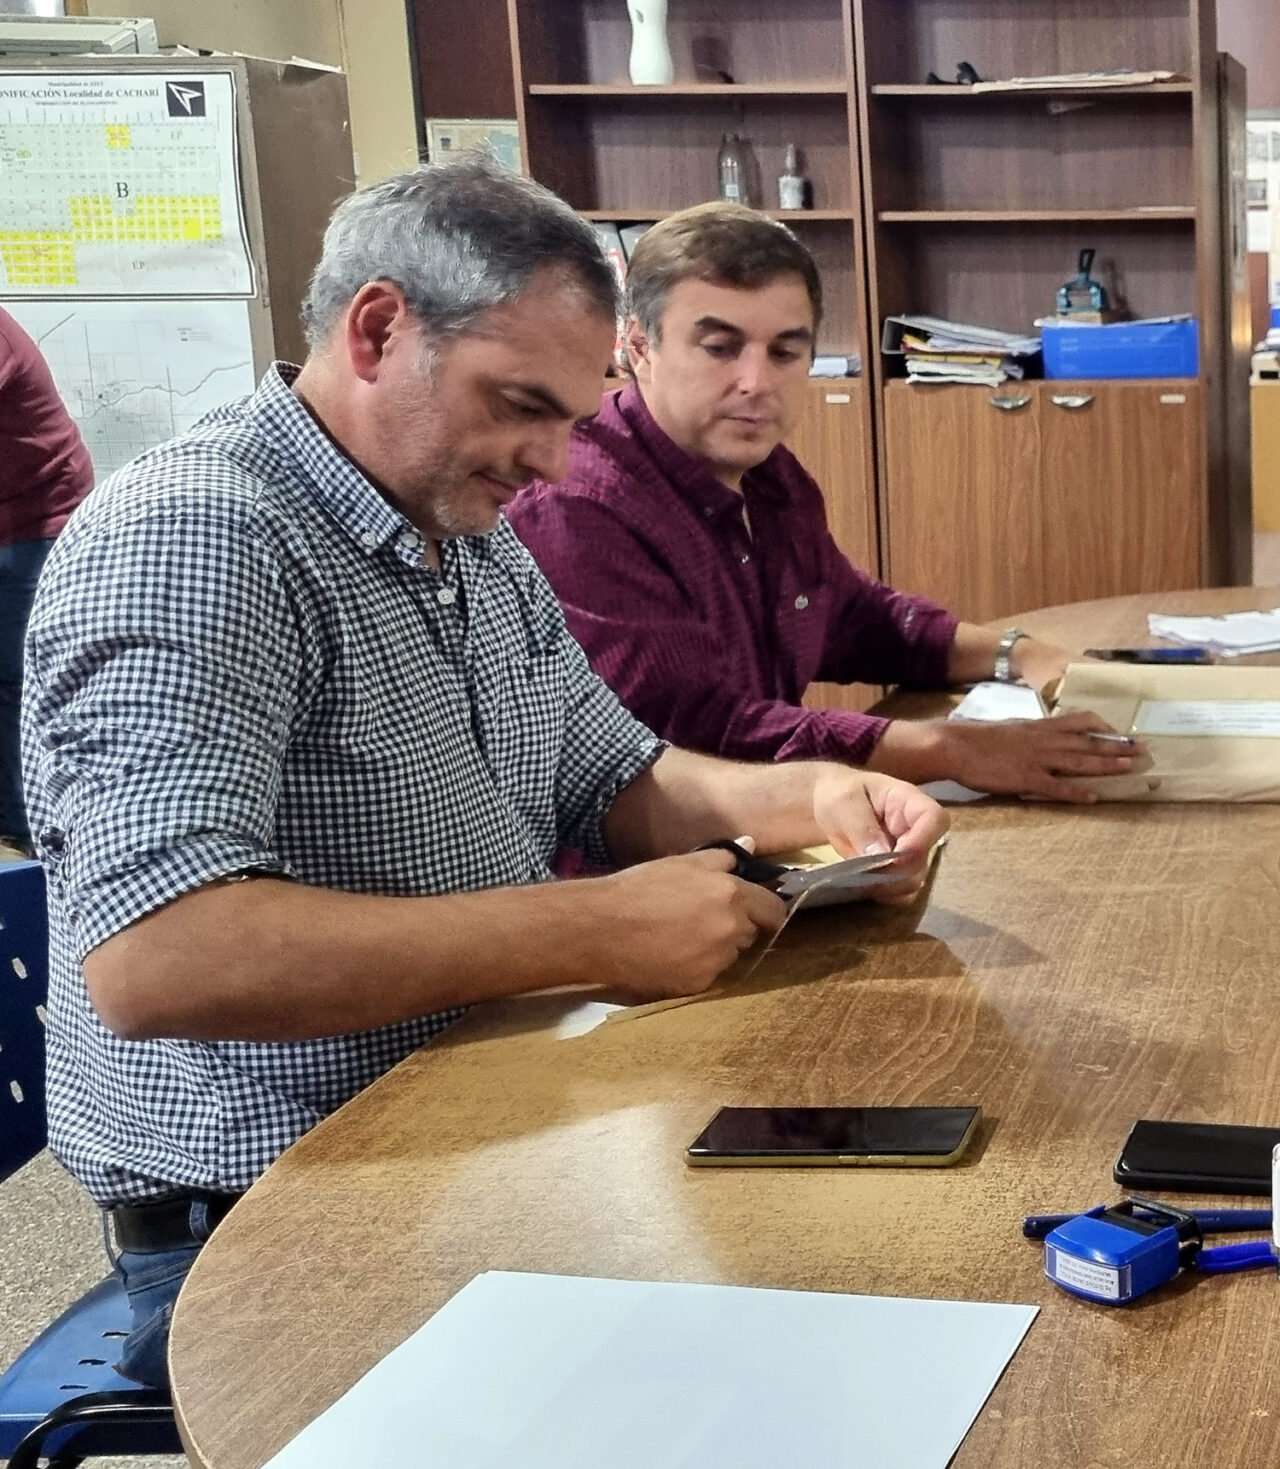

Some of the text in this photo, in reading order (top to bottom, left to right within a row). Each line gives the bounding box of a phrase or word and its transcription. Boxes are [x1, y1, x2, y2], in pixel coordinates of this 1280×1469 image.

[63, 89, 103, 98] Localidad
[105, 89, 114, 98] de
[115, 86, 159, 97] CACHARÍ
[116, 181, 129, 198] B
